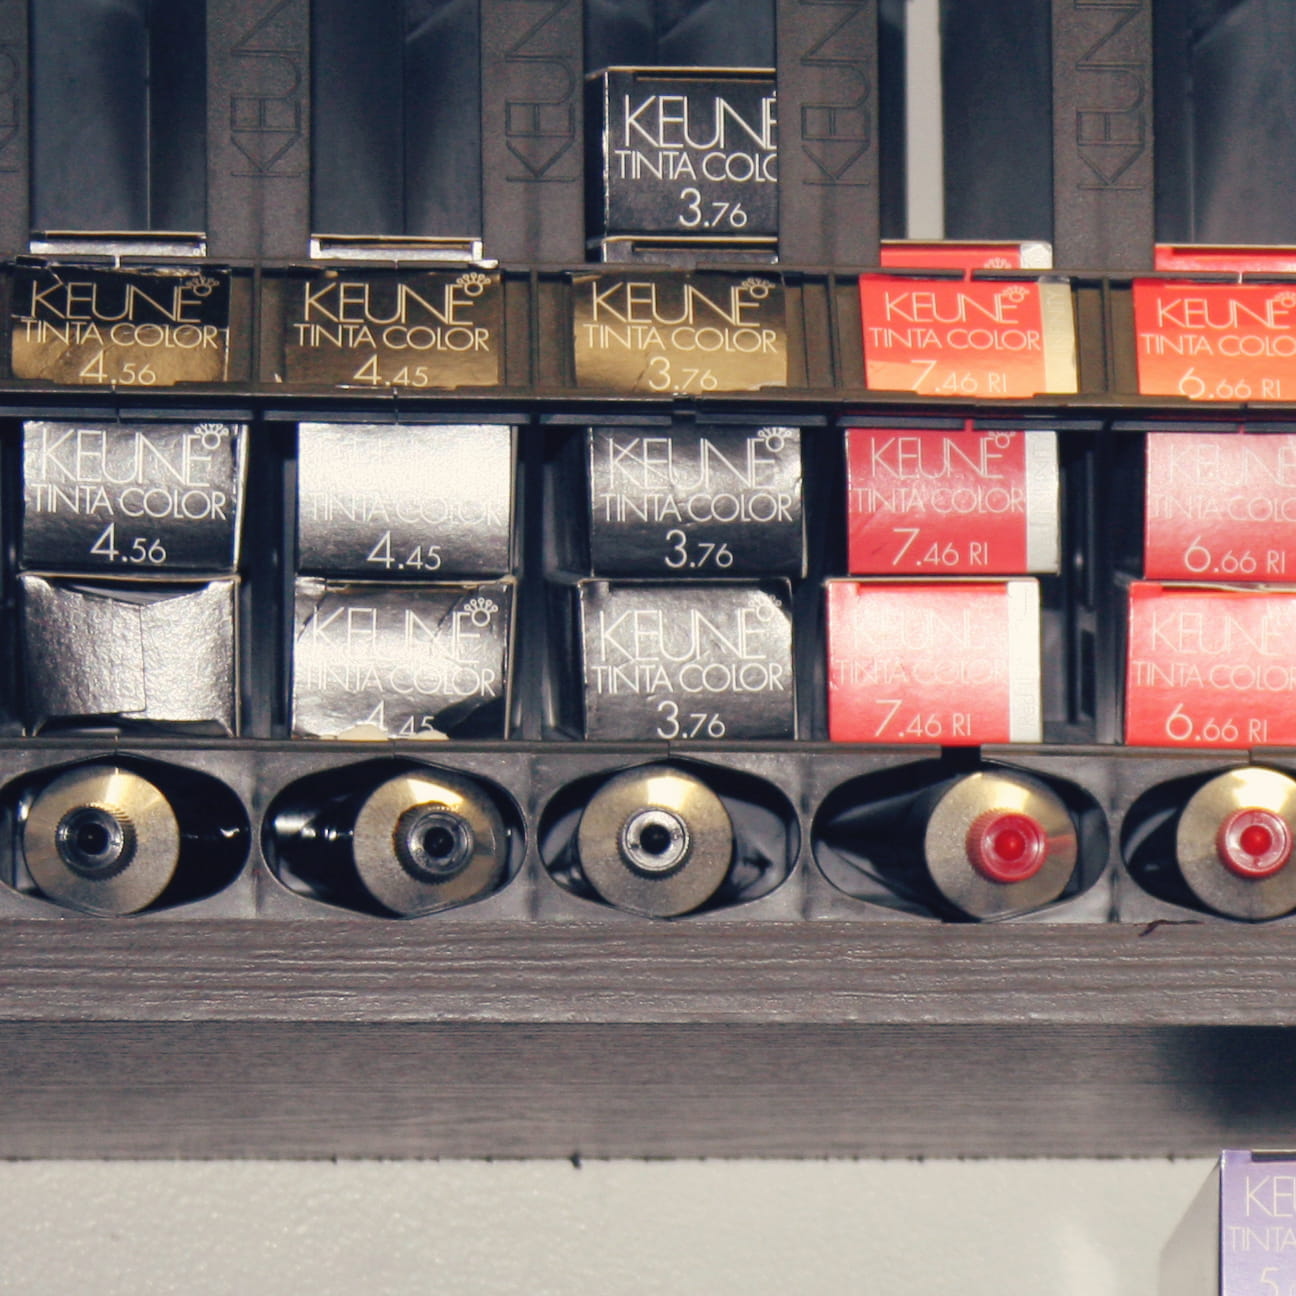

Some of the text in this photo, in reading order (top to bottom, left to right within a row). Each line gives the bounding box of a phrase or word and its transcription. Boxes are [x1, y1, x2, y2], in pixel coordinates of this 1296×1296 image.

[30, 283, 203, 322] KEUNE
[304, 283, 474, 326] KEUNE
[593, 284, 761, 326] KEUNE
[883, 292, 1019, 325] KEUNE
[21, 322, 219, 350] TINTA COLOR
[294, 323, 490, 352] TINTA COLOR
[582, 326, 778, 353] TINTA COLOR
[870, 326, 1040, 351] TINTA COLOR
[79, 354, 156, 385] 4.56
[353, 356, 429, 388] 4.45
[647, 356, 719, 391] 3.76
[910, 359, 1007, 394] 7.46 RI
[608, 439, 774, 490] KEUNE
[870, 439, 1003, 478] KEUNE
[600, 492, 794, 523] TINTA COLOR
[852, 486, 1024, 514] TINTA COLOR
[664, 529, 734, 567] 3.76
[892, 529, 989, 565] 7.46 RI
